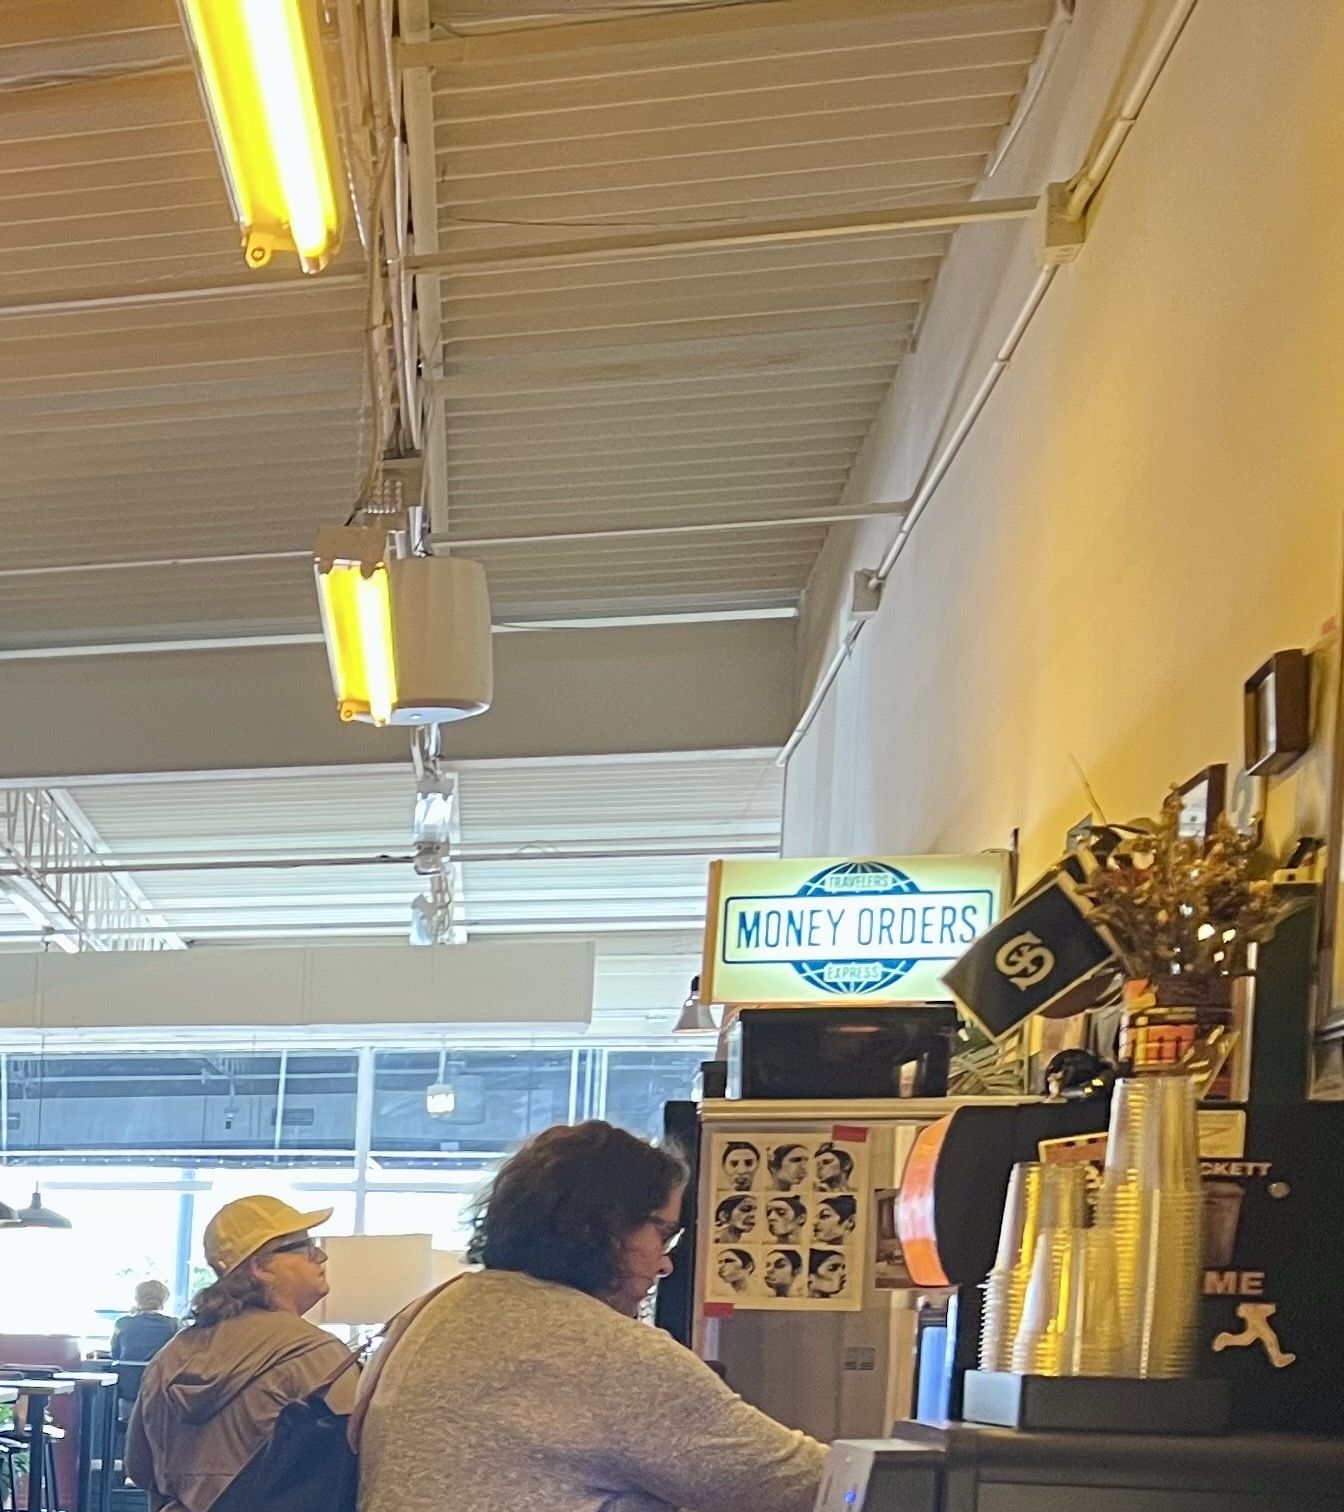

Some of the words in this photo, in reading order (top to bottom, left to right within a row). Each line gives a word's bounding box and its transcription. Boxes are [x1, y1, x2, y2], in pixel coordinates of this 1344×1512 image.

[828, 874, 889, 889] TRAVELERS
[736, 909, 845, 948] MONEY
[857, 905, 978, 946] ORDERS
[827, 966, 880, 980] EXPRESS
[1200, 1162, 1272, 1177] CKETT
